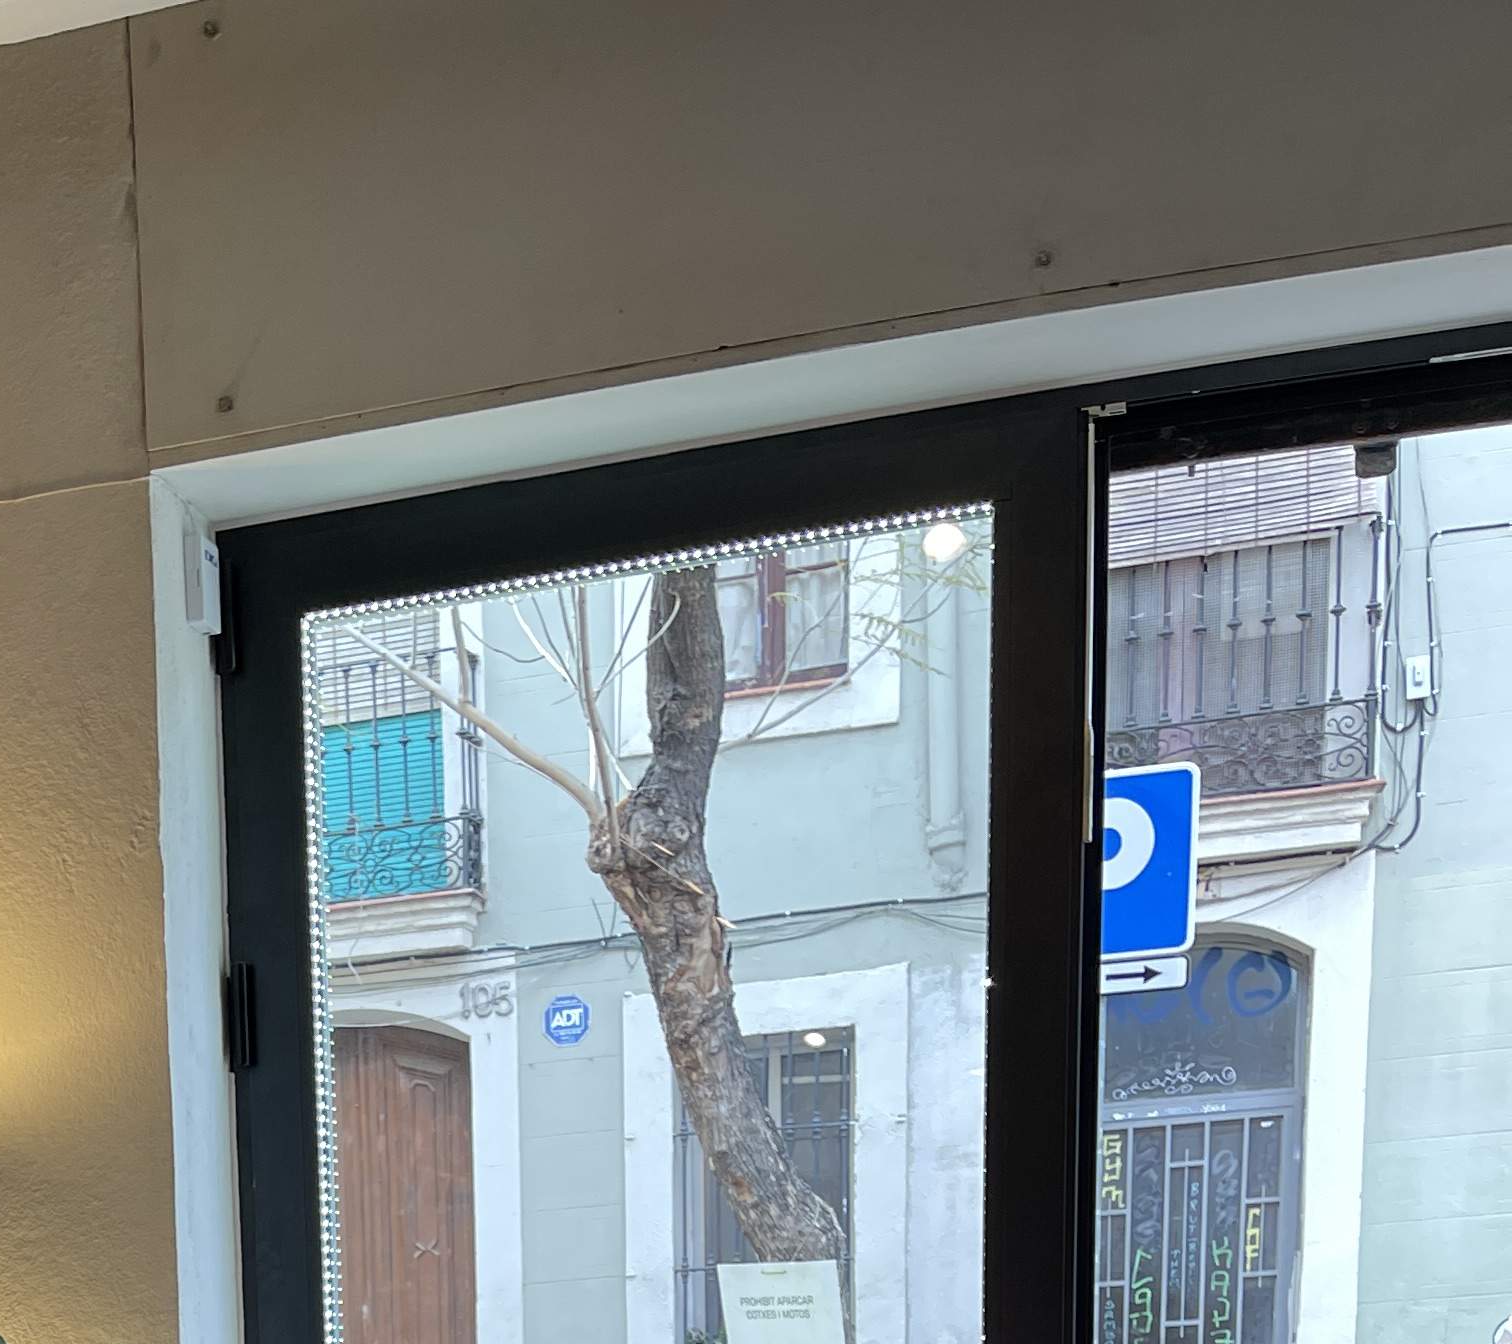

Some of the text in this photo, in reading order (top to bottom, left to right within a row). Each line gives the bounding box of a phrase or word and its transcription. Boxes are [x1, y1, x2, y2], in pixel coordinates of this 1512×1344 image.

[551, 1008, 583, 1029] ADT
[777, 1295, 814, 1306] APARCAR
[782, 1309, 811, 1319] MOTOS
